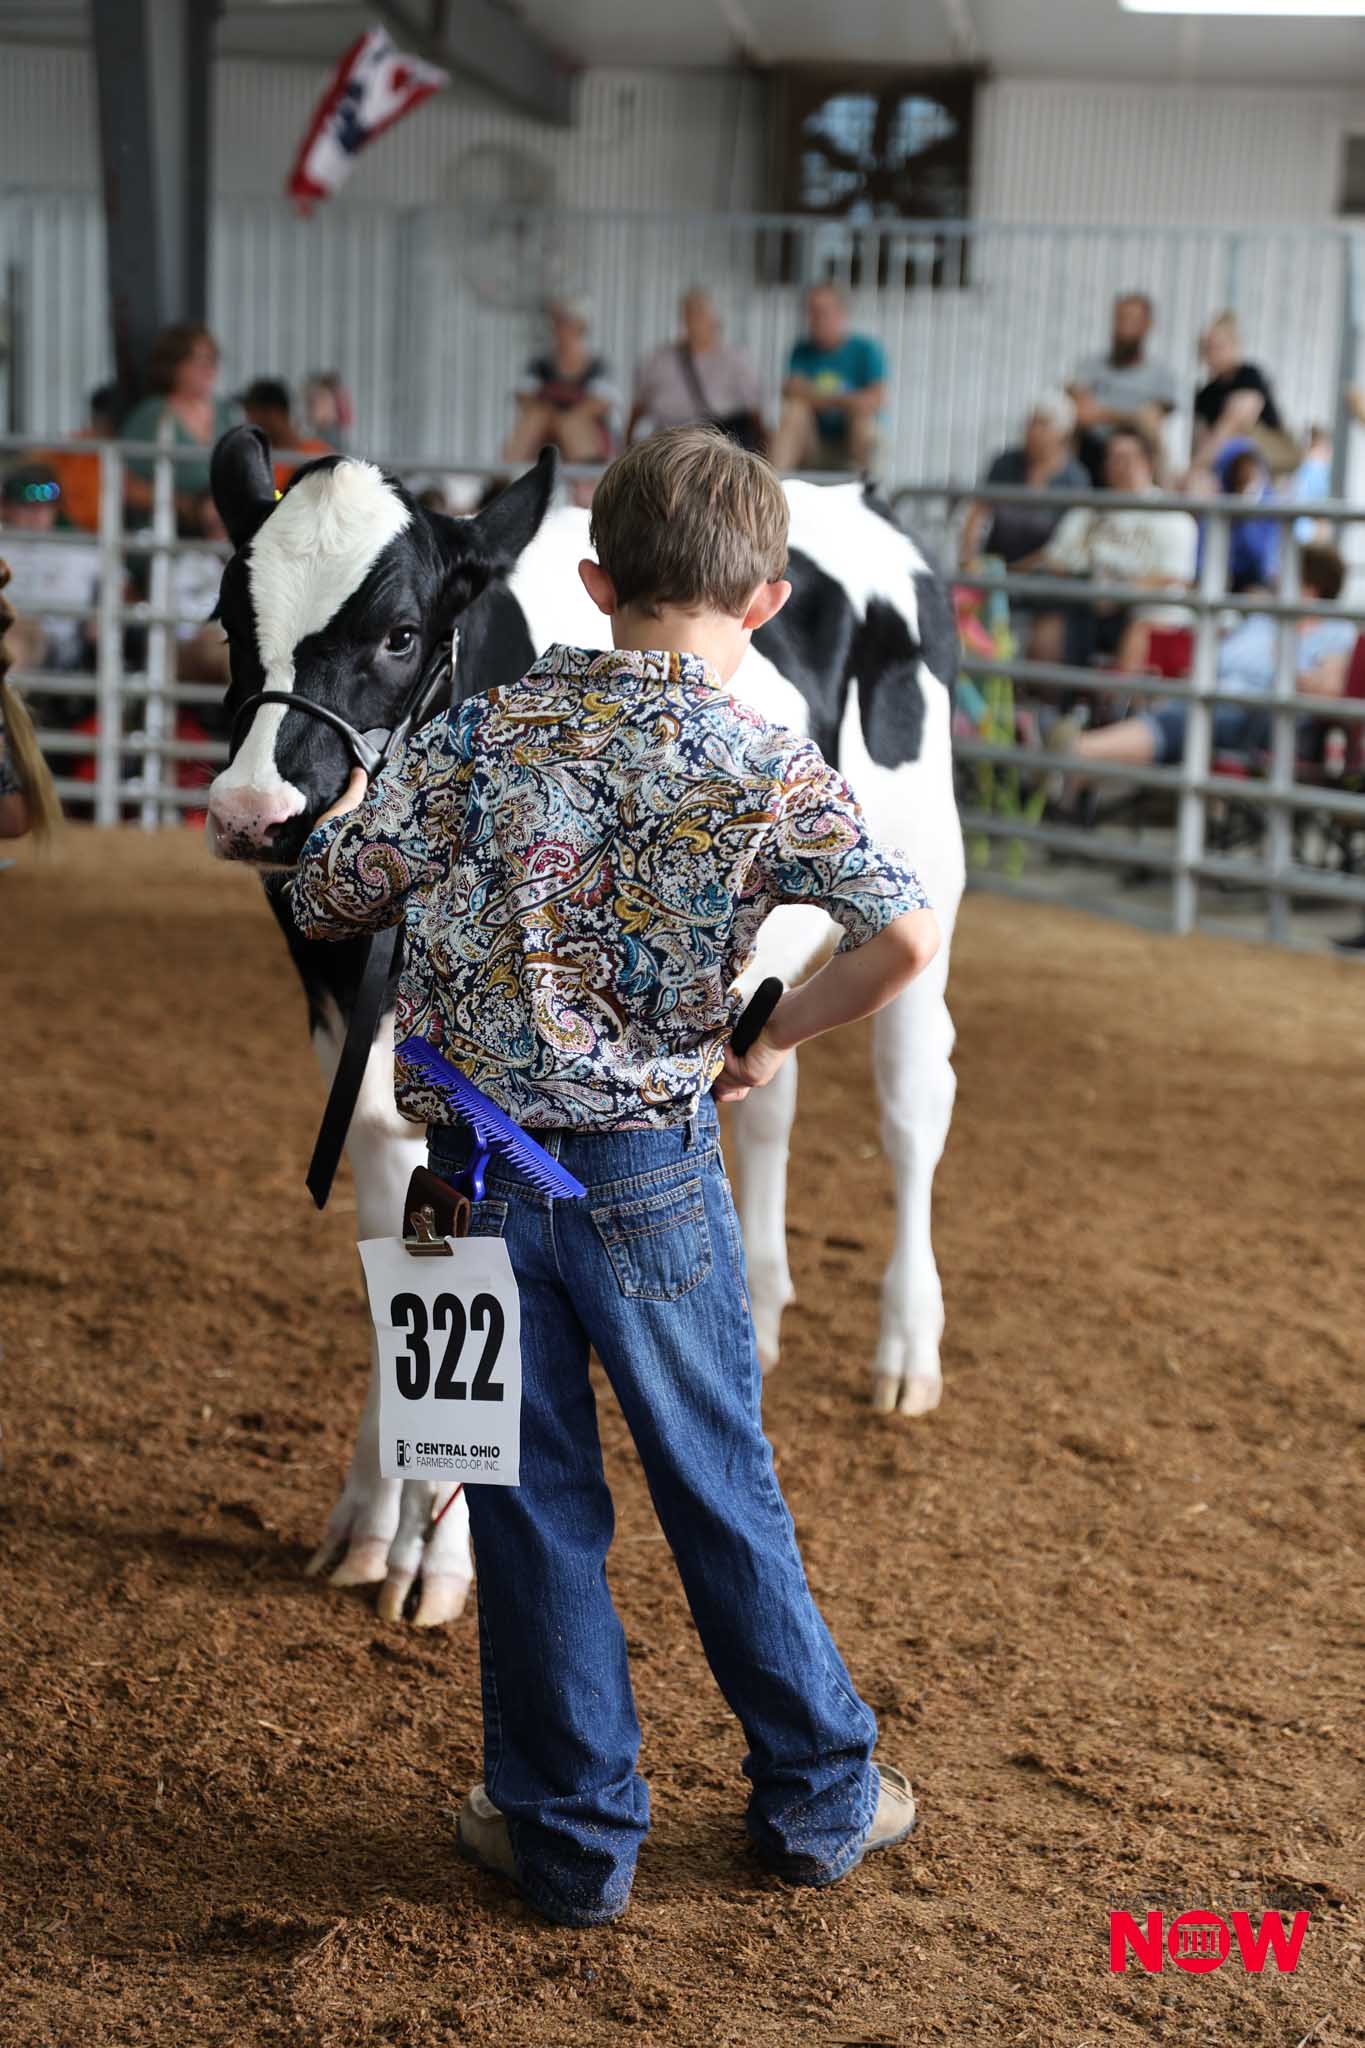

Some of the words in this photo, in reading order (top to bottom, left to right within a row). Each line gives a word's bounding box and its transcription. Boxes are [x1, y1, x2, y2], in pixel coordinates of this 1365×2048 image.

[391, 1293, 505, 1401] 322
[415, 1442, 467, 1457] CENTRAL
[470, 1445, 500, 1458] OHIO
[416, 1456, 454, 1469] FARMERS
